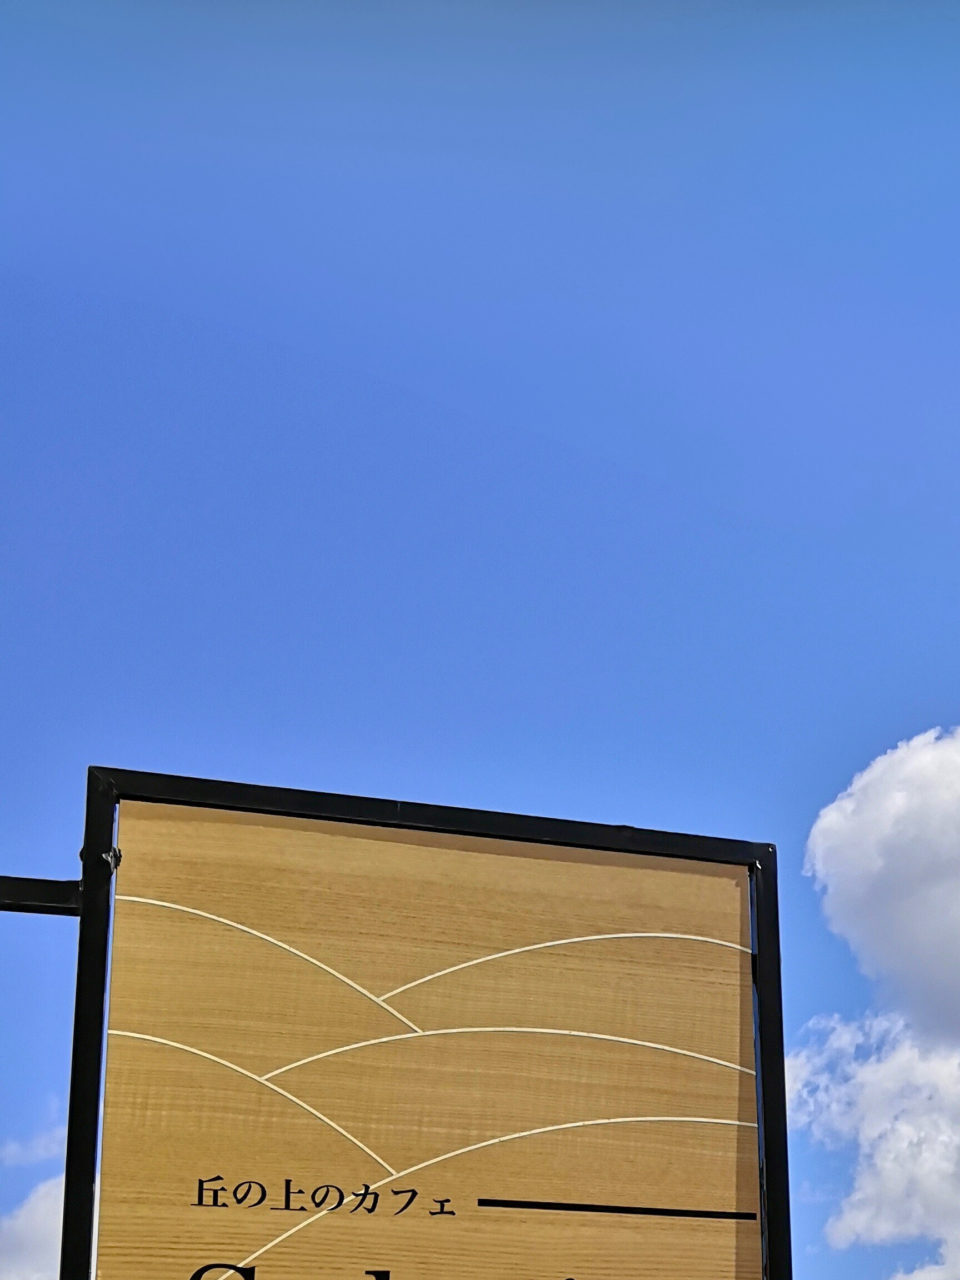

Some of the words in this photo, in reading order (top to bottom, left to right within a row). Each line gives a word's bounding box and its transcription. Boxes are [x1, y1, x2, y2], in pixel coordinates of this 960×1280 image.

[190, 1175, 457, 1217] 丘の上のカフェ
